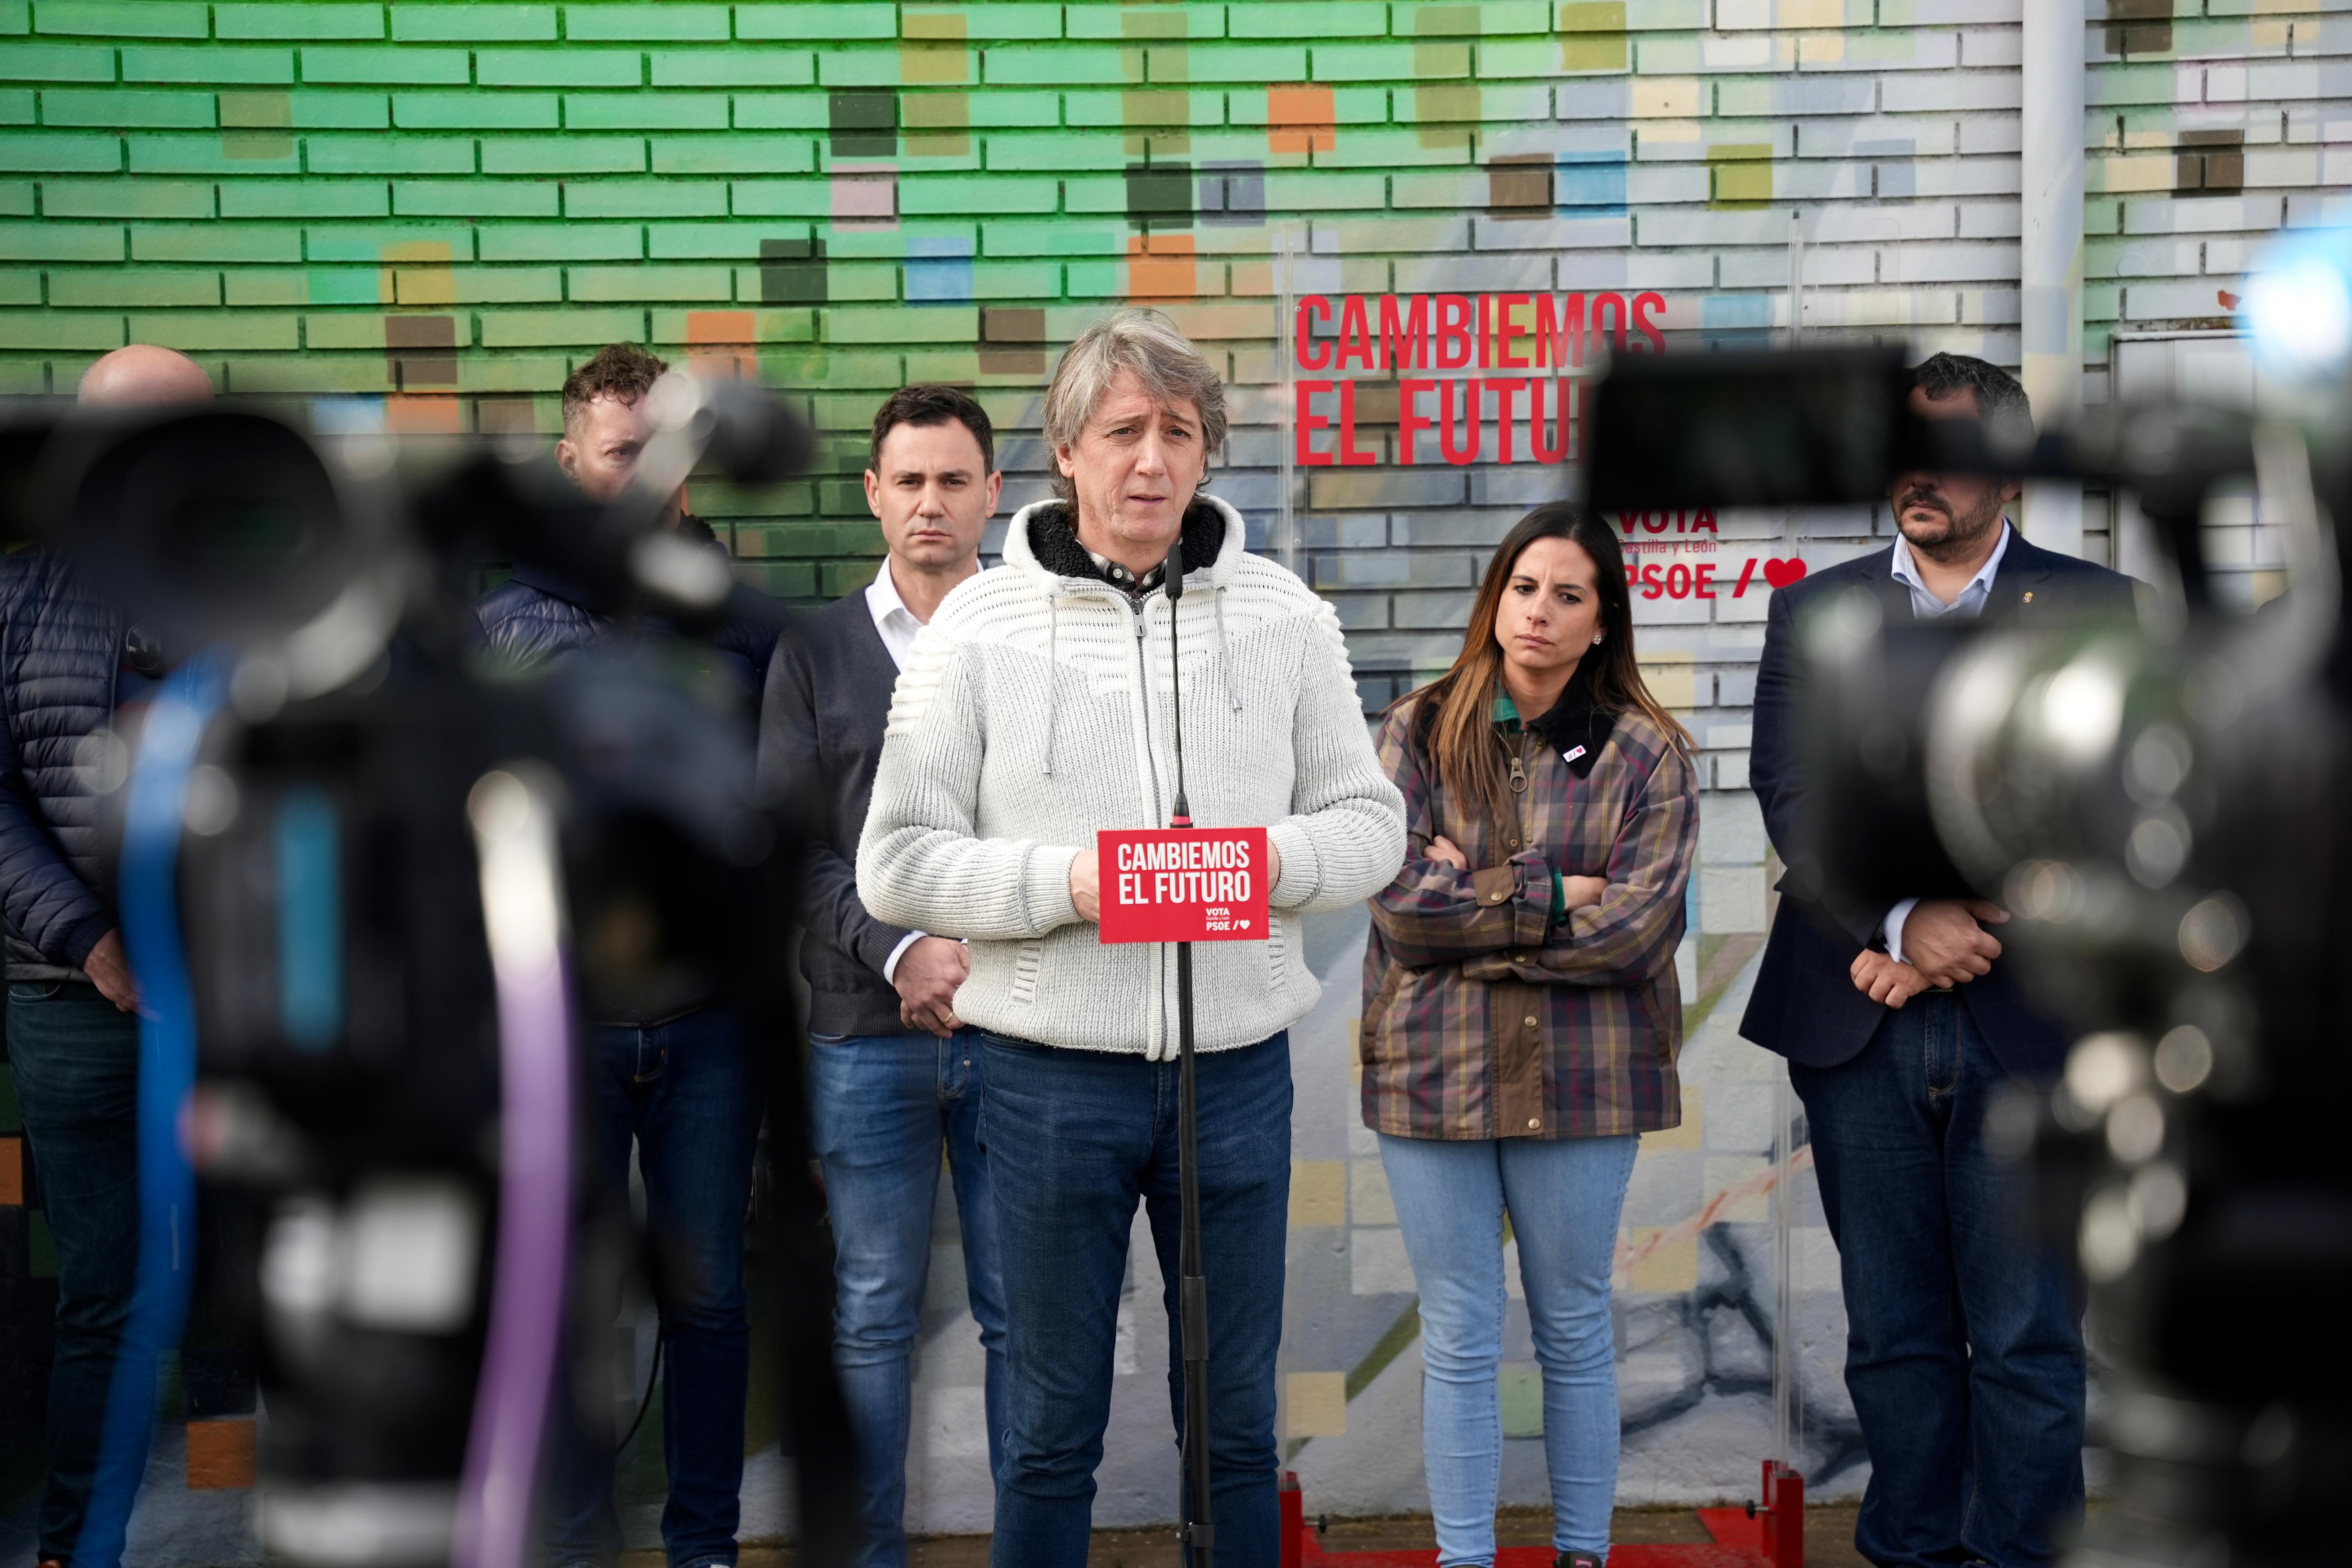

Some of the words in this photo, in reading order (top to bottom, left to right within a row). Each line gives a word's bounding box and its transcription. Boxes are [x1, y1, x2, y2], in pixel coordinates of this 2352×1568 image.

[1295, 291, 1666, 370] CAMBIEMOS
[1295, 379, 1376, 466] EL
[1399, 378, 1591, 466] FUTU
[1617, 506, 1719, 534] VOTA
[1672, 542, 1679, 557] y
[1685, 538, 1717, 553] León
[1118, 840, 1250, 872] CAMBIEMOS
[1119, 873, 1148, 905] EL
[1155, 871, 1250, 904] FUTURO
[1206, 907, 1230, 916] VOTA
[1206, 921, 1230, 931] PSOE
